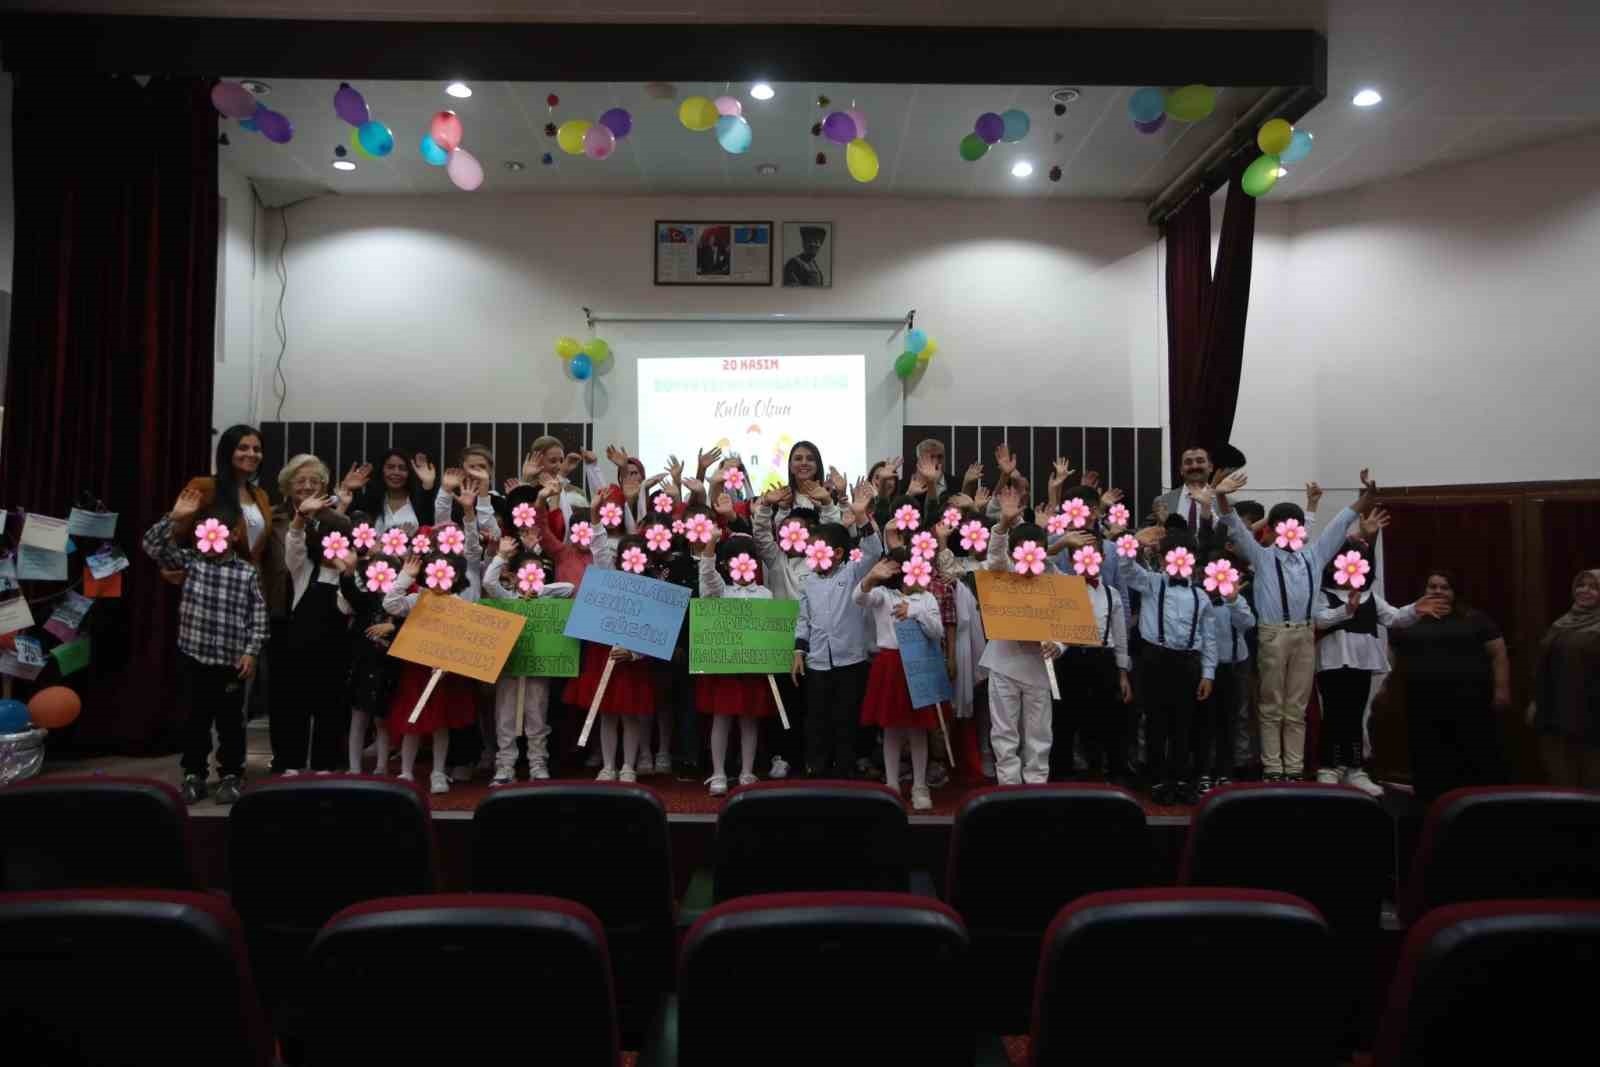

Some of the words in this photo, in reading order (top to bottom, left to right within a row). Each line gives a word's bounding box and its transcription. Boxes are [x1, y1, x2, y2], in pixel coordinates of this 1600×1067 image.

[722, 359, 737, 370] 20
[740, 358, 779, 370] KASIM
[753, 393, 792, 418] Olsun
[600, 615, 668, 646] GÜCÜM
